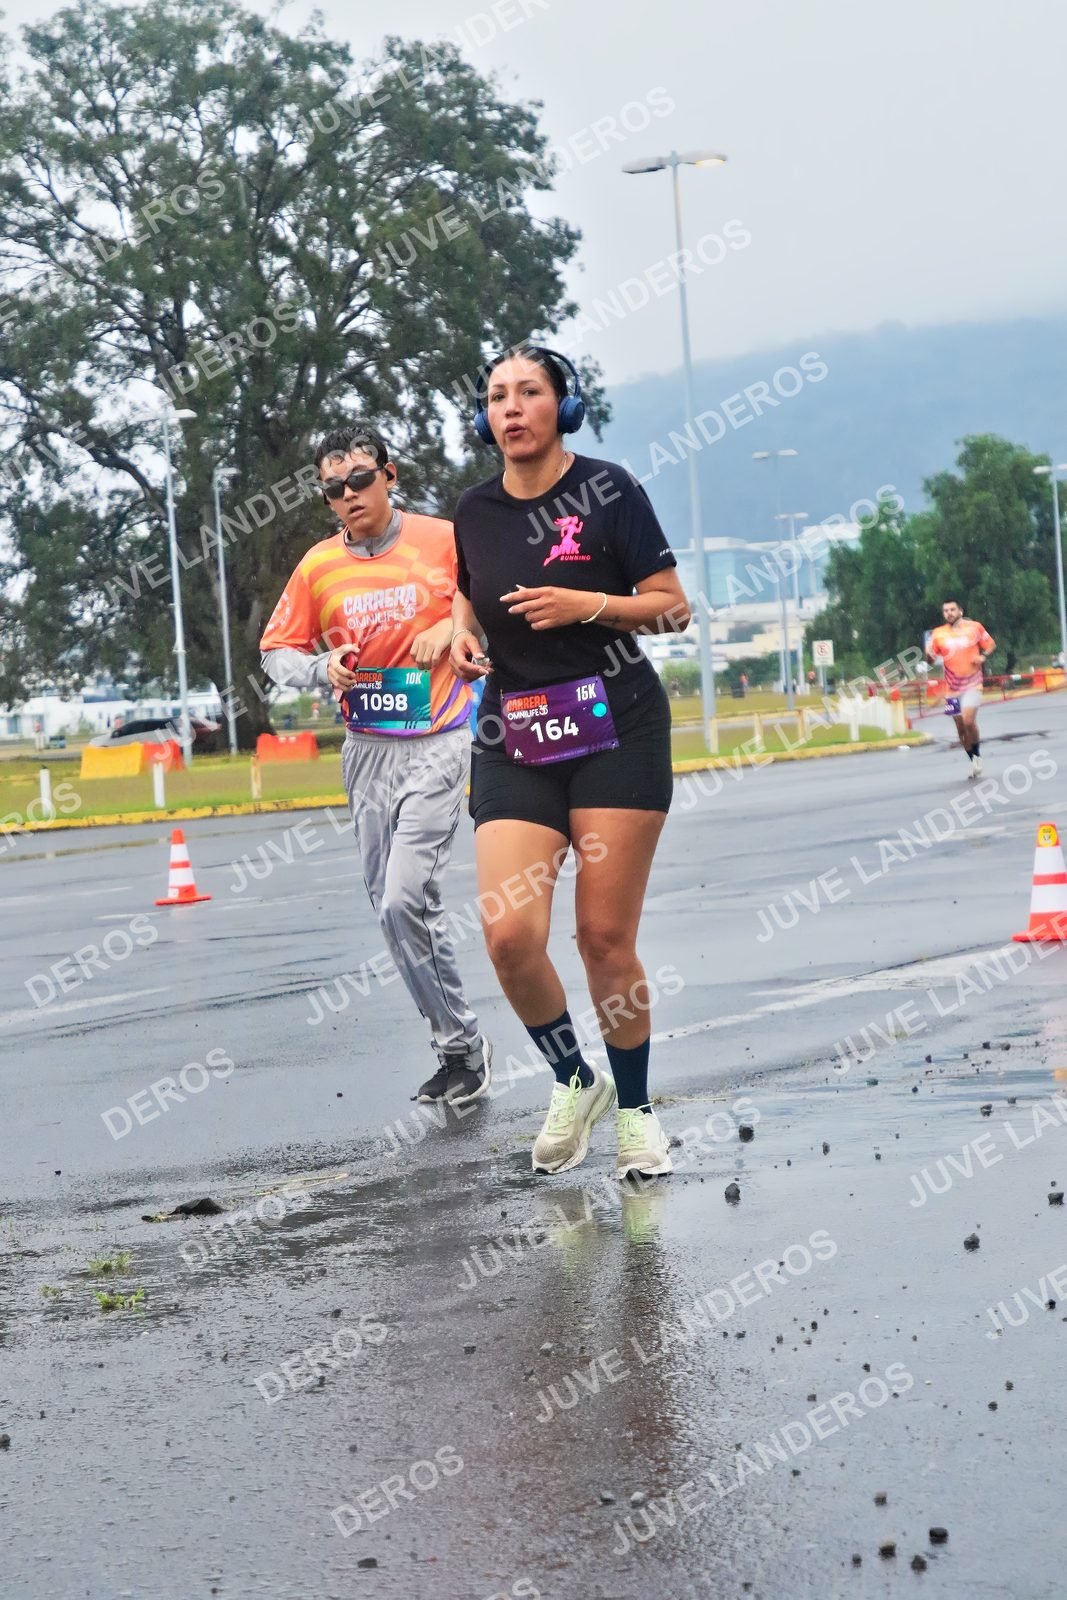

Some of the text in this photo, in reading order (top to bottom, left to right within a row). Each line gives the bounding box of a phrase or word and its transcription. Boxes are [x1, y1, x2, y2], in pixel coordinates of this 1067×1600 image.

[343, 584, 417, 616] CARRERA
[353, 671, 383, 683] ARRERA
[405, 672, 422, 685] 10K
[360, 693, 408, 711] 1098
[507, 694, 548, 712] CARRERA
[507, 708, 540, 721] OMNILIFE
[530, 716, 580, 743] 164
